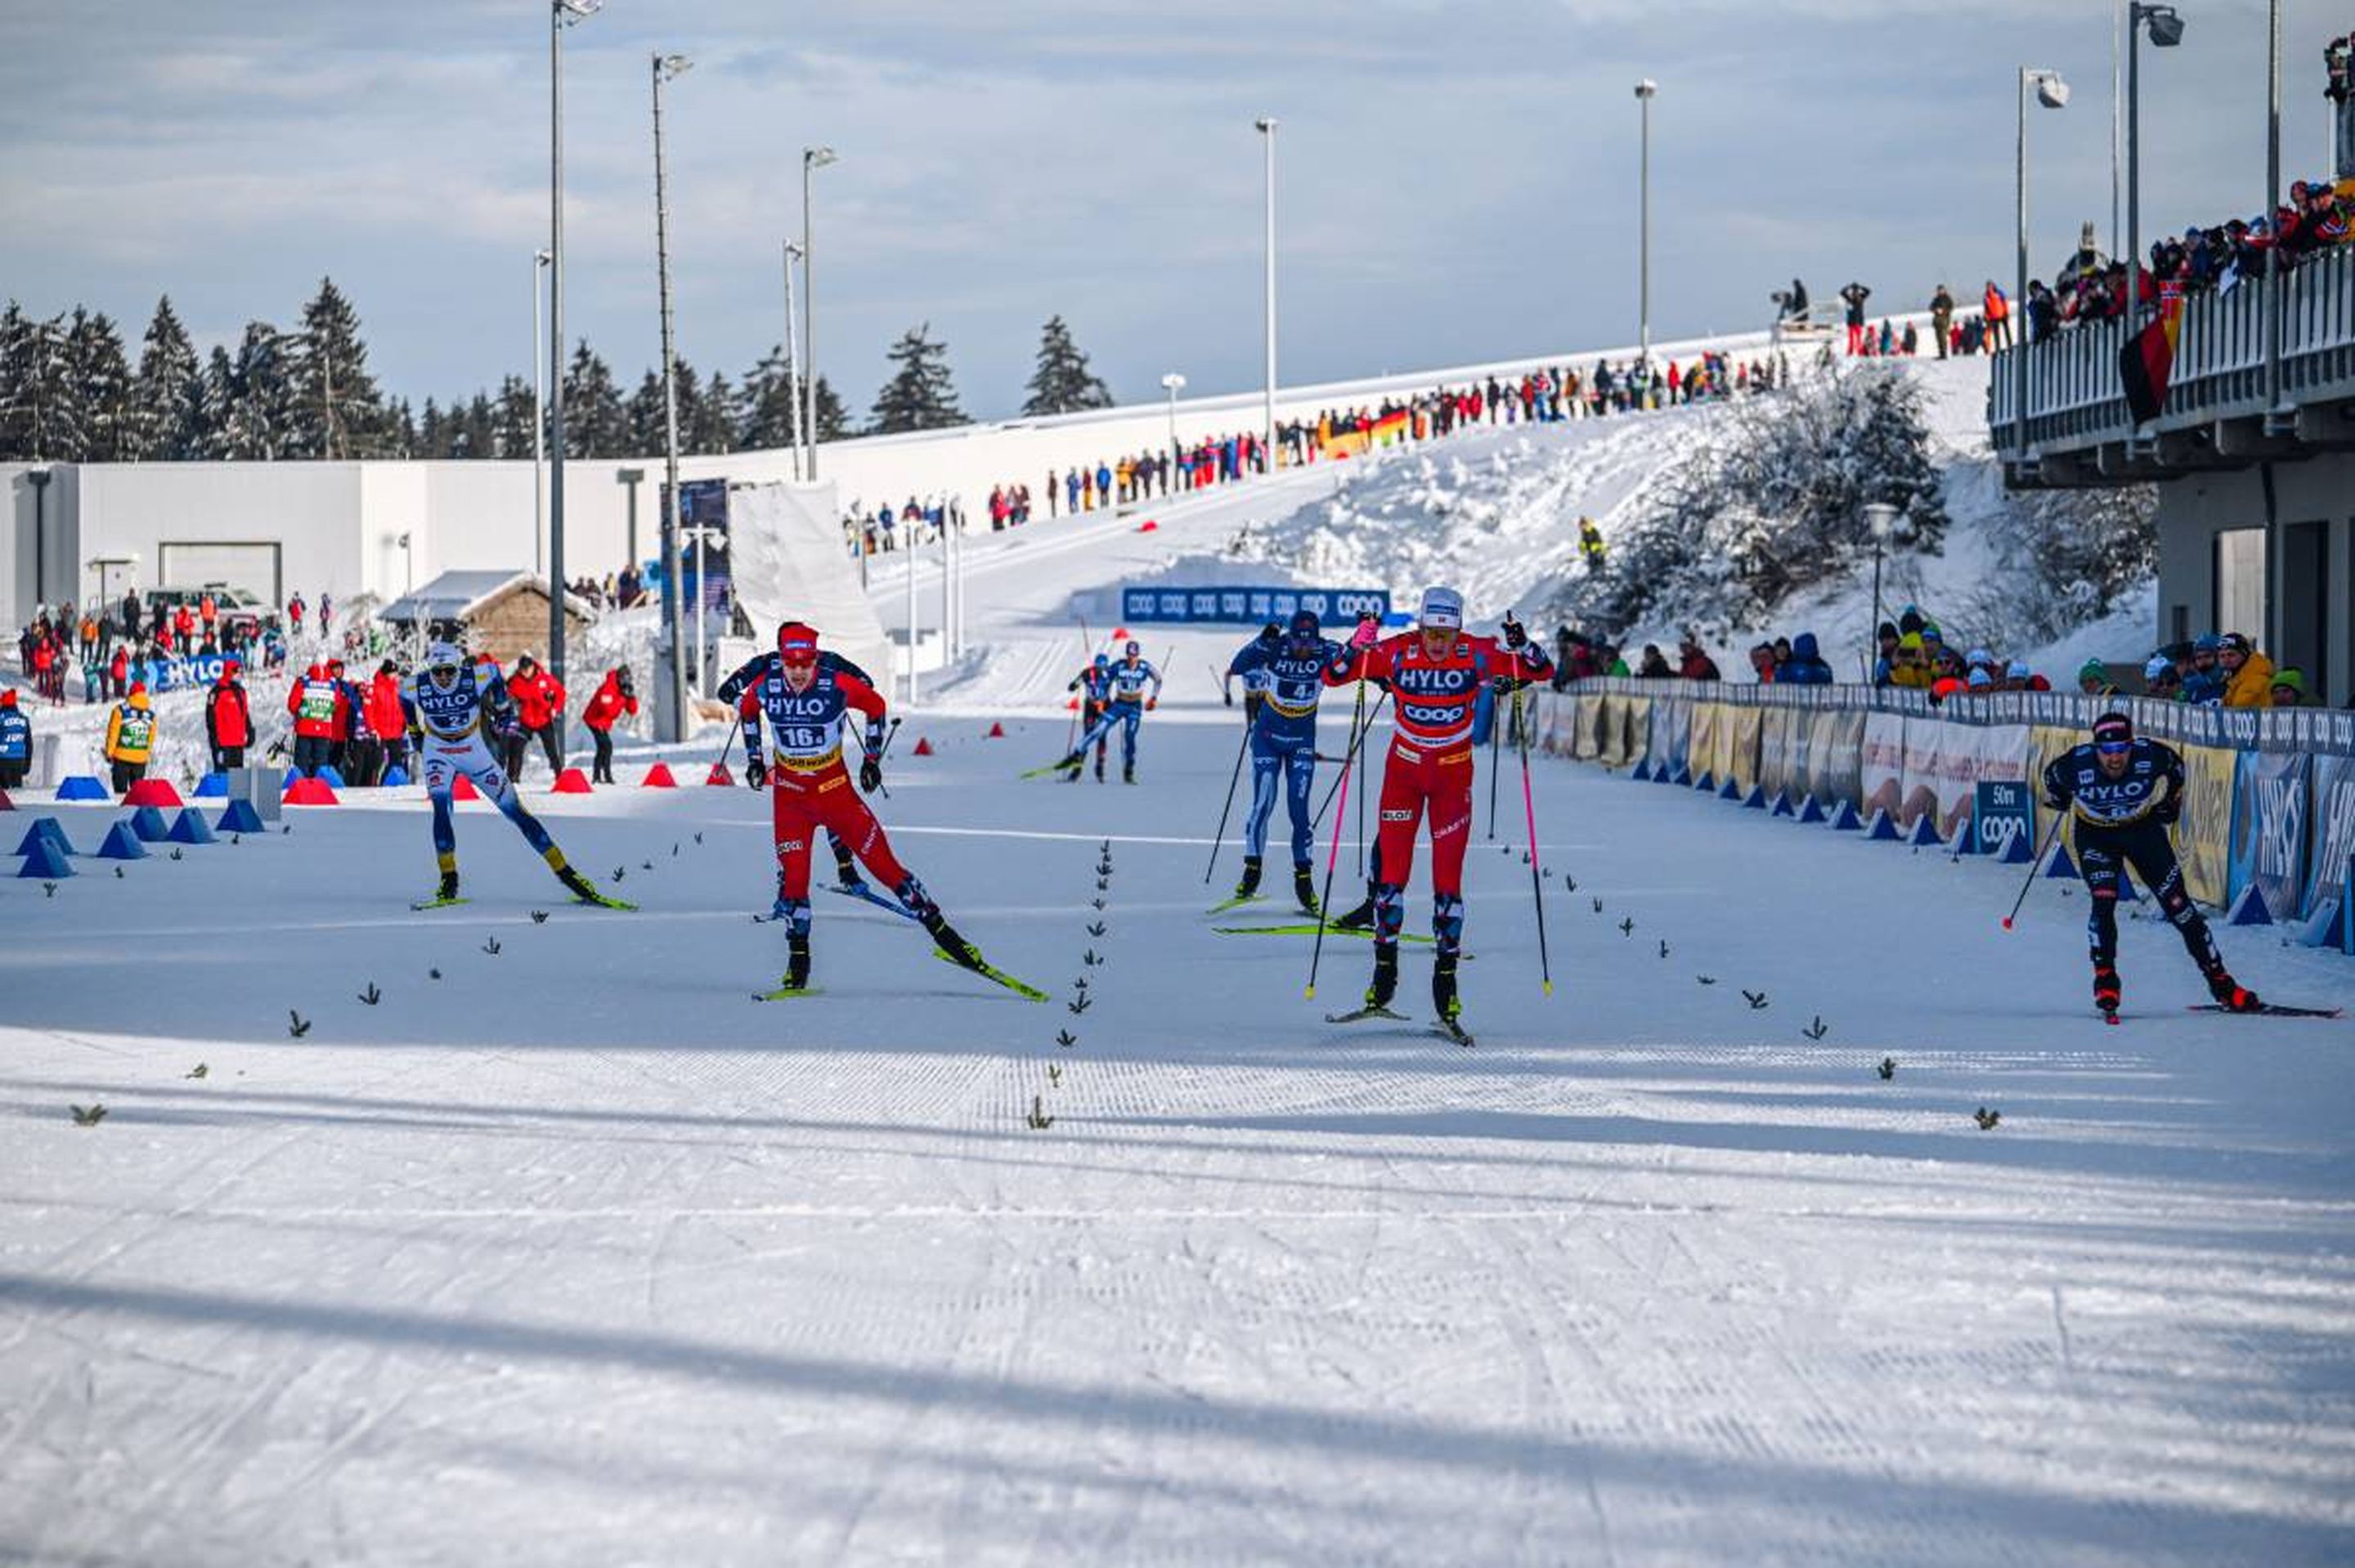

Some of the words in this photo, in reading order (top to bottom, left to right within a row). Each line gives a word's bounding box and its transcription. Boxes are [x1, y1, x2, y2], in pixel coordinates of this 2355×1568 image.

[1337, 594, 1384, 619] coop
[168, 659, 224, 686] HYLO
[1275, 659, 1319, 674] HYLO
[1399, 669, 1464, 688] HYLO
[420, 693, 469, 710] HYLO
[768, 697, 824, 716] HYLO
[1404, 704, 1465, 724] coop
[2078, 782, 2143, 800] HYLO
